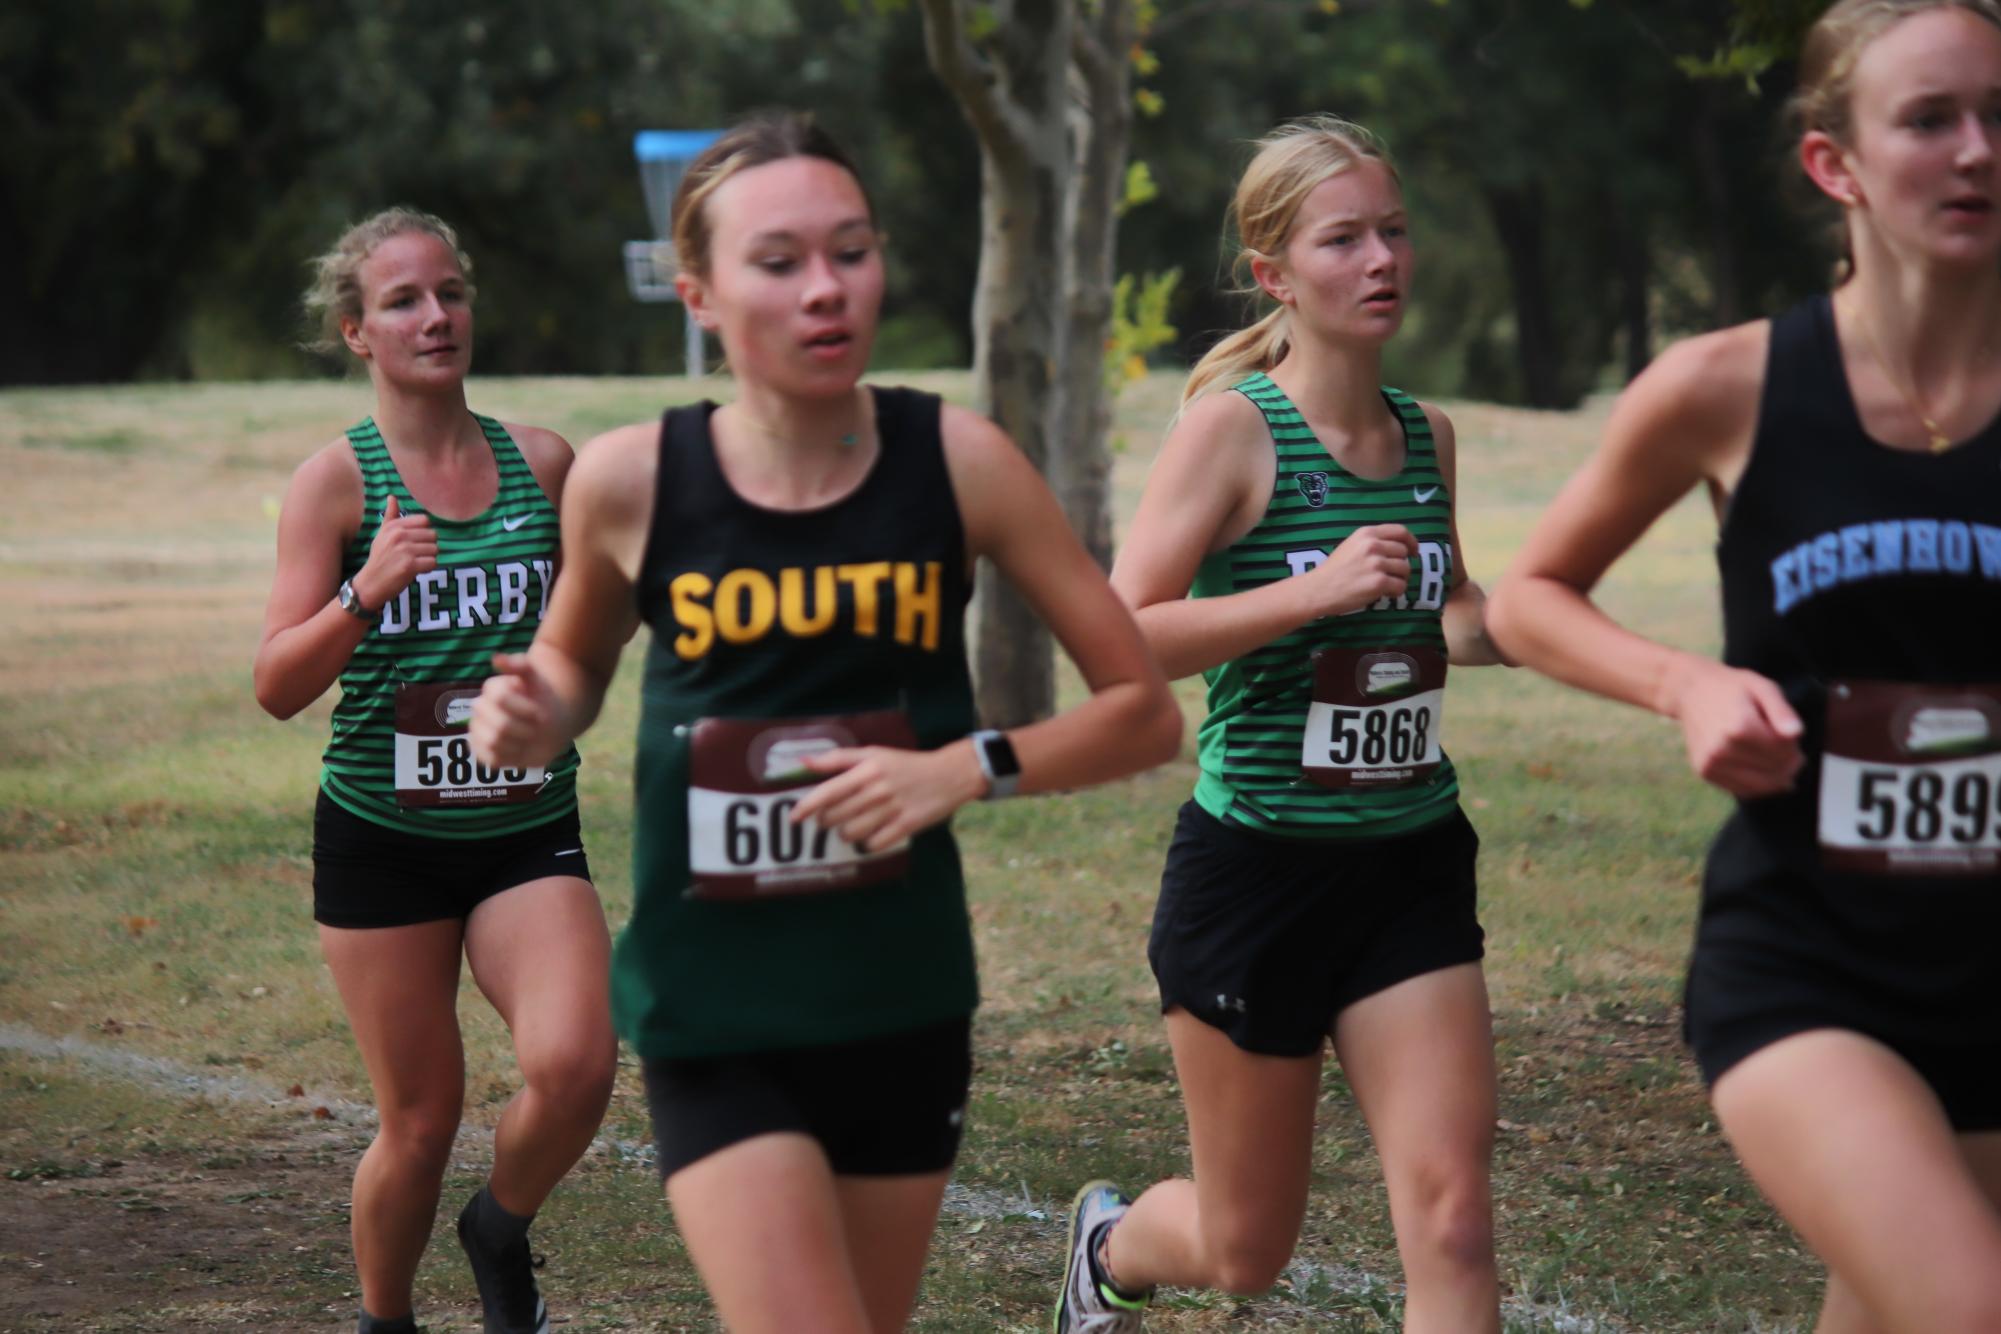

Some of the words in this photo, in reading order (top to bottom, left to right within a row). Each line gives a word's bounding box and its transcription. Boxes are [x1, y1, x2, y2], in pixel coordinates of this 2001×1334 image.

[380, 559, 553, 634] DERBY
[670, 561, 942, 661] SOUTH
[1329, 706, 1430, 765] 5868
[1856, 769, 2001, 843] 589
